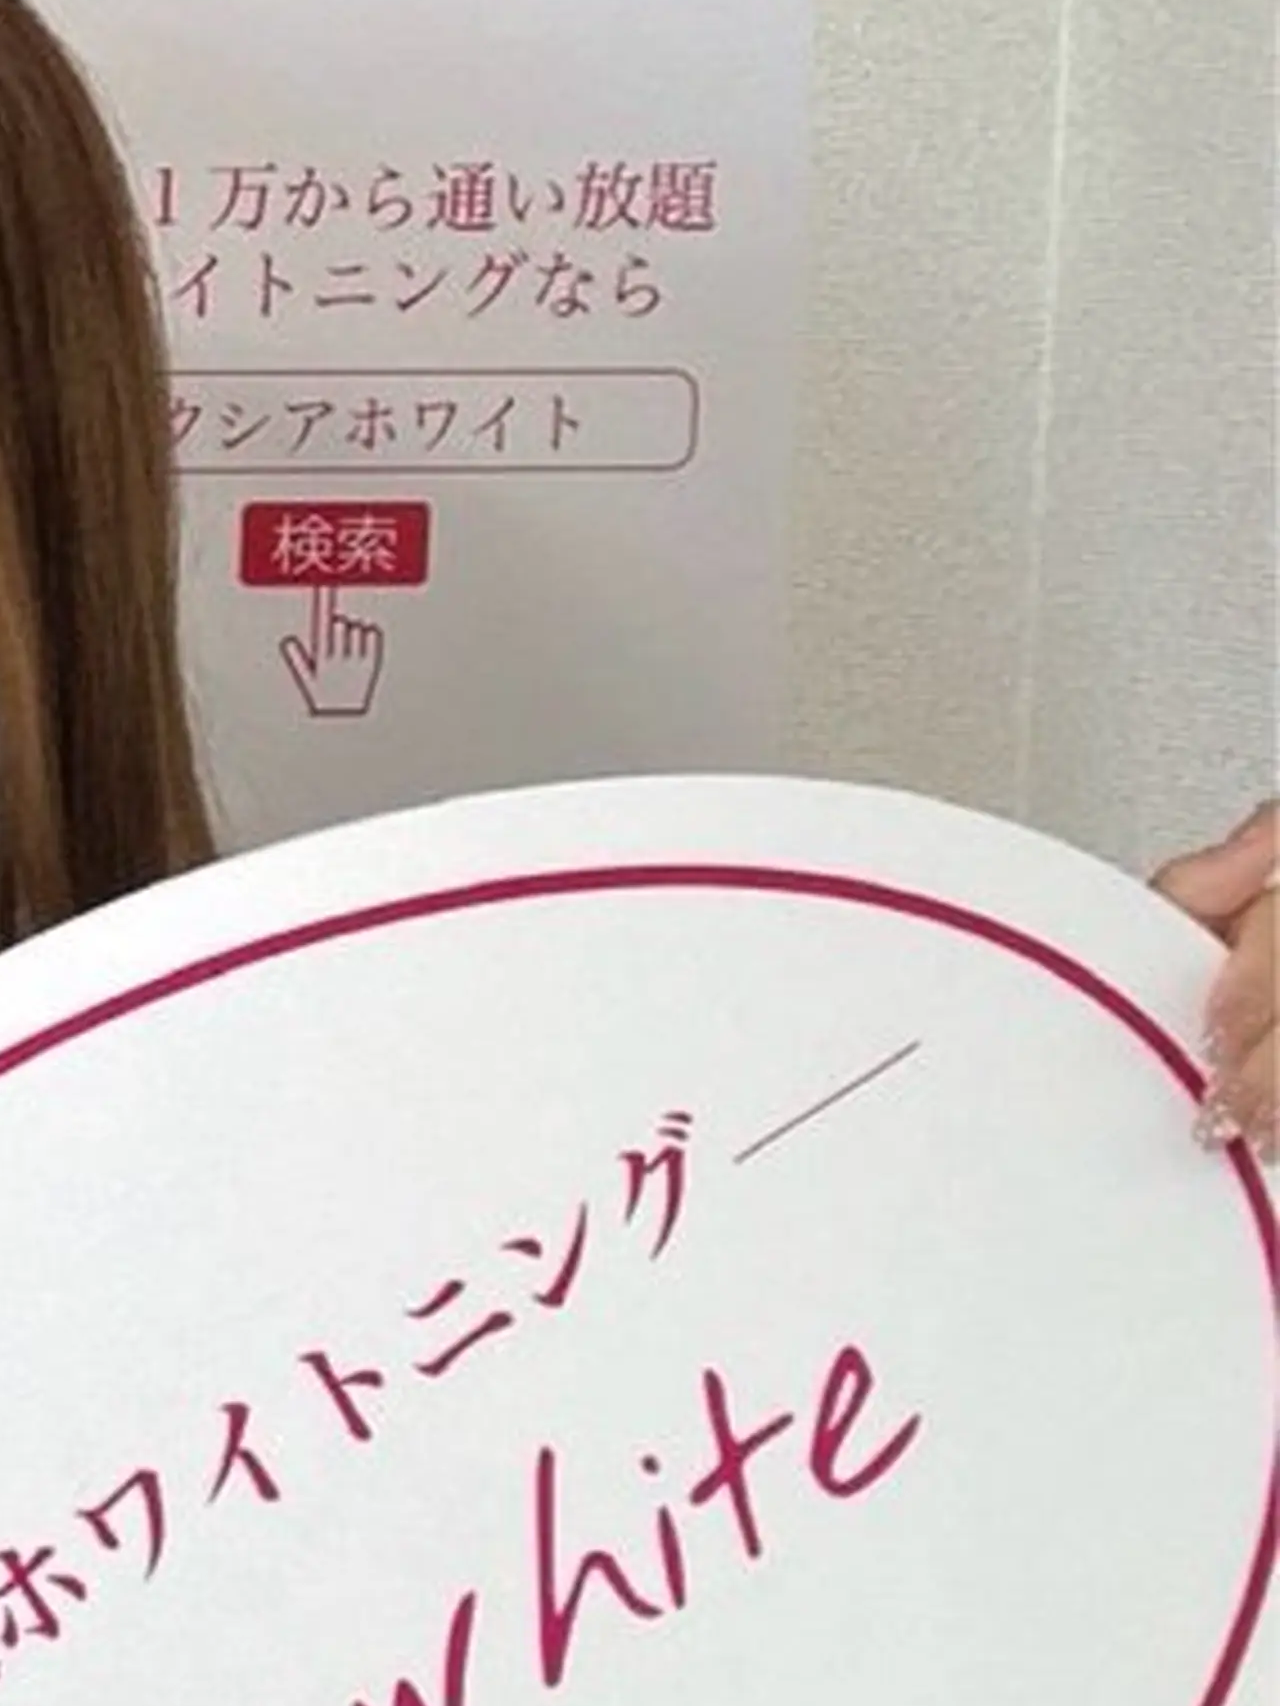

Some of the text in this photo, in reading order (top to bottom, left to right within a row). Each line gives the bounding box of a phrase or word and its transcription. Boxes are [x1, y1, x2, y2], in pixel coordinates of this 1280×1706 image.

[174, 251, 662, 318] イトニングなら
[271, 513, 398, 573] 検索
